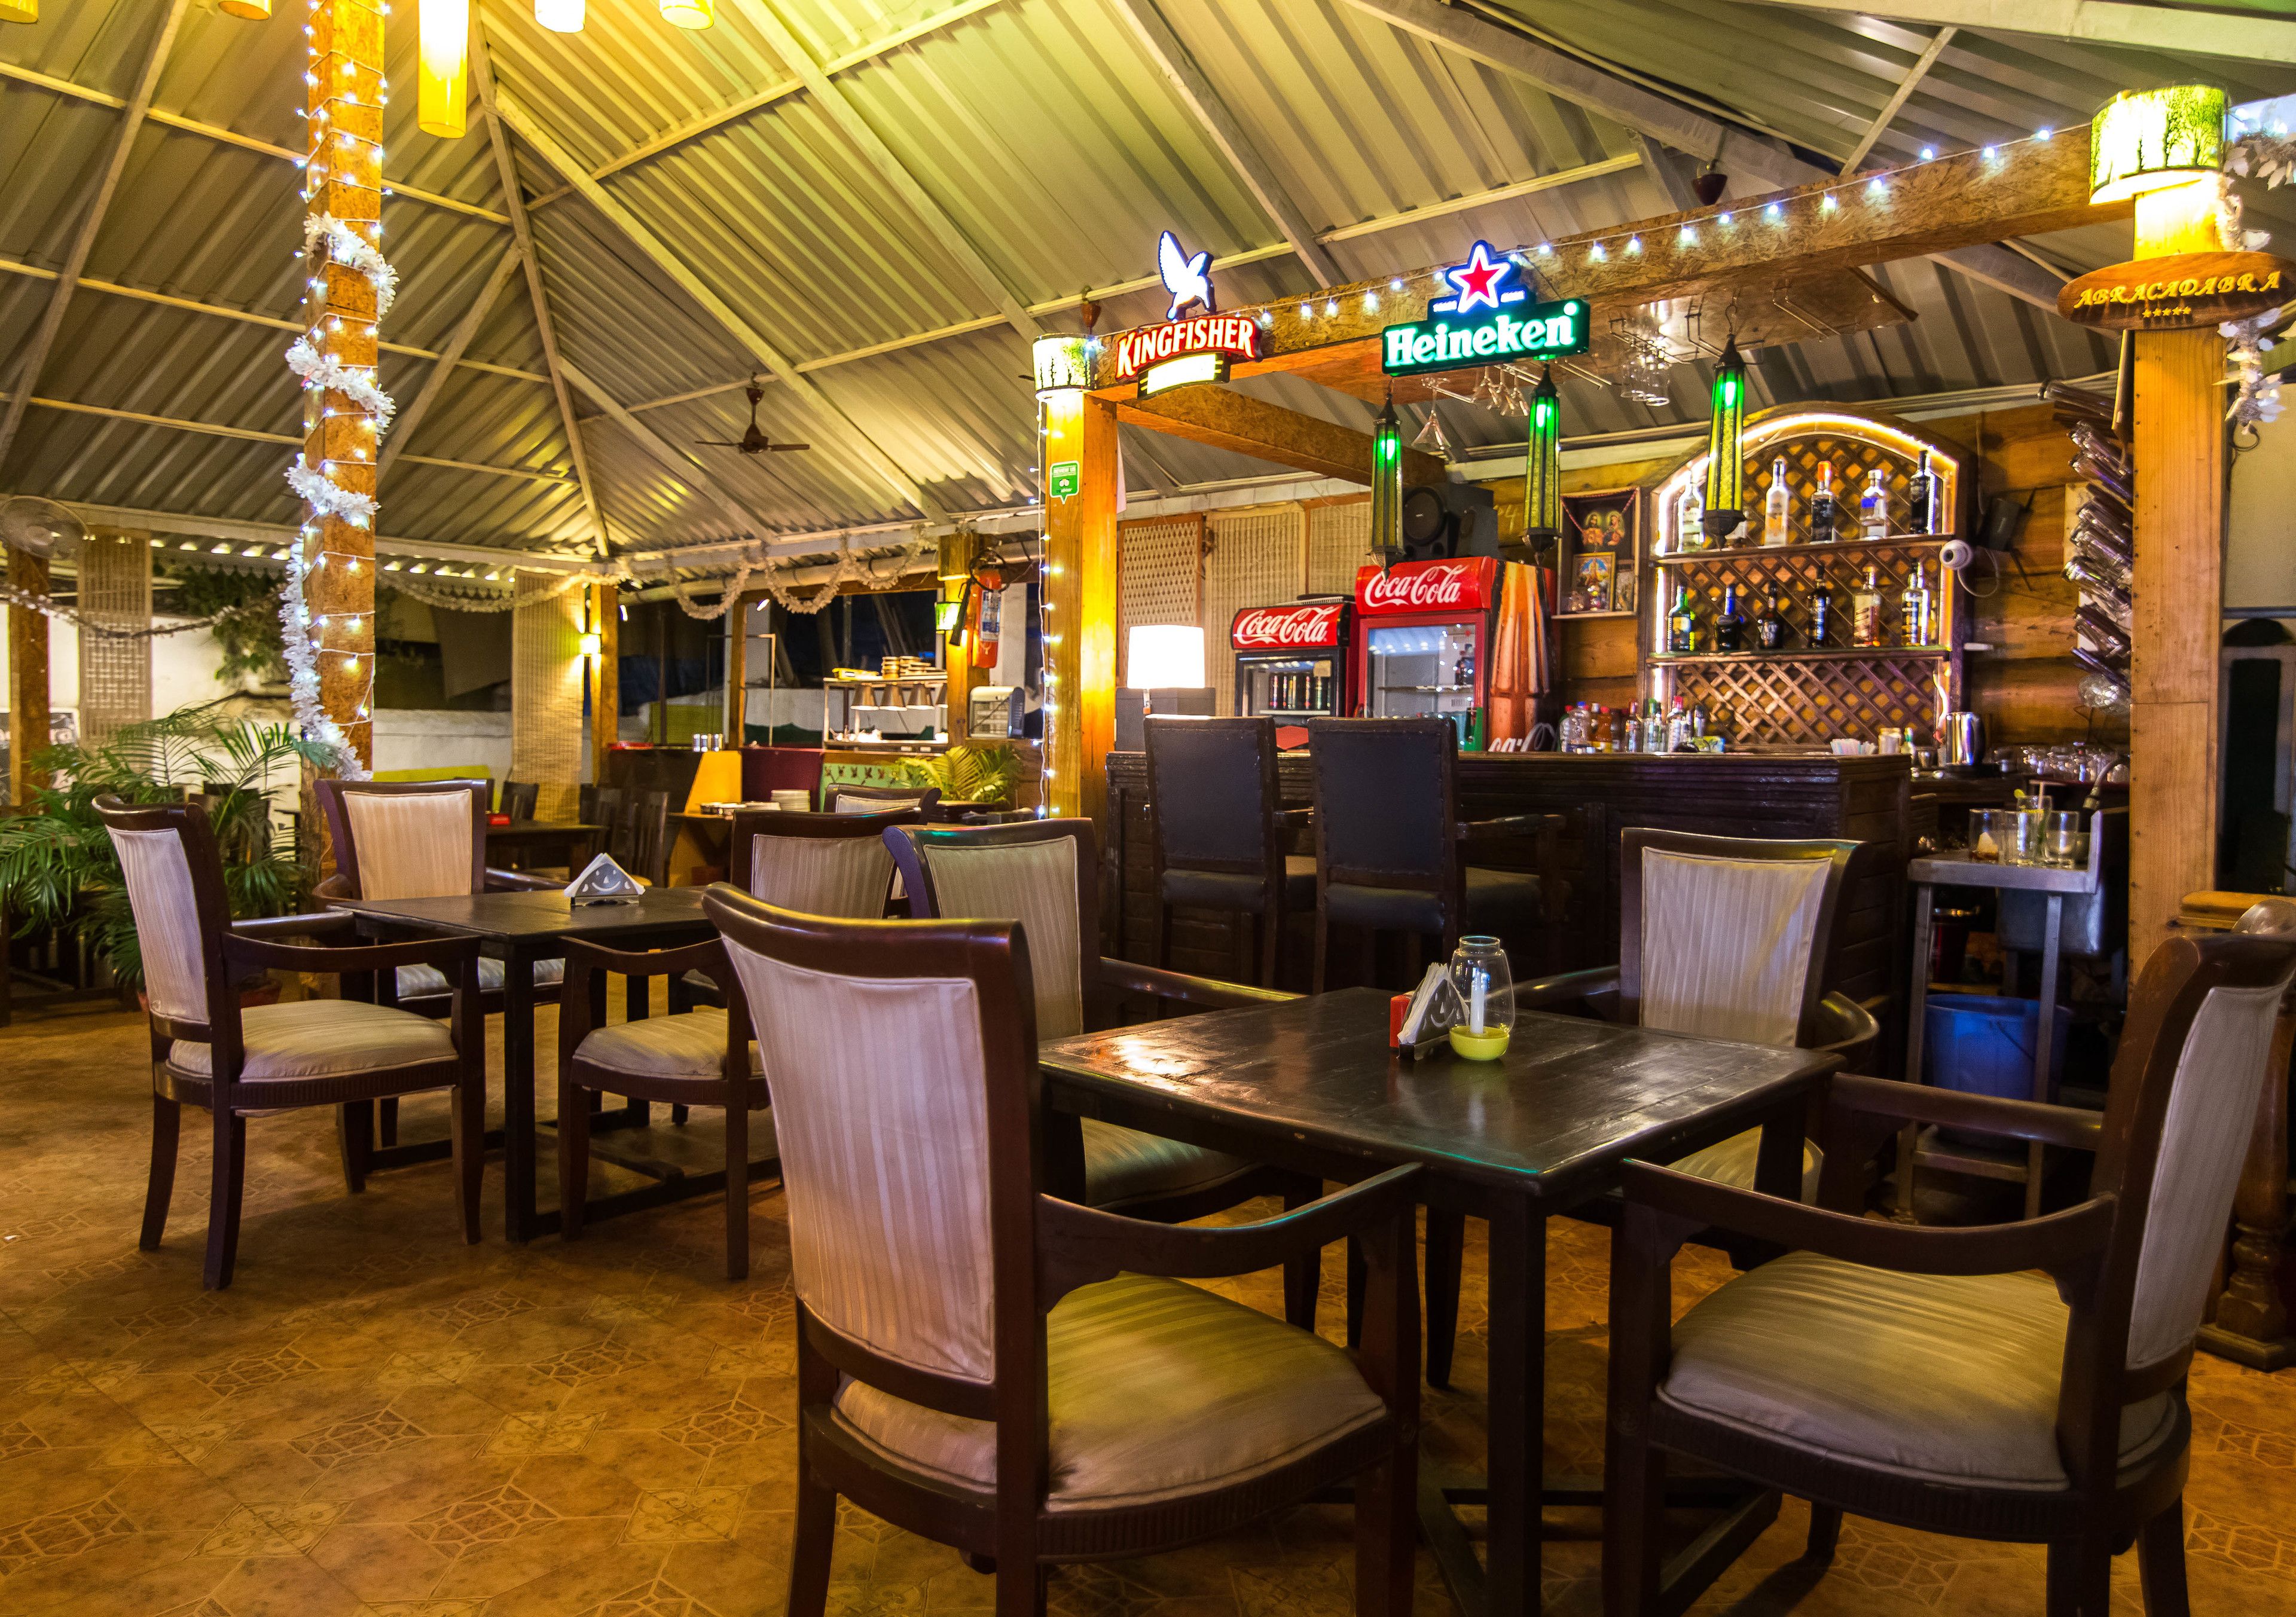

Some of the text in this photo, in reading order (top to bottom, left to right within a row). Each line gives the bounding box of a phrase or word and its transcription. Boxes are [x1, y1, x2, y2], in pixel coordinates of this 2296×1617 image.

[2073, 271, 2281, 309] ABRACADABRA
[1115, 318, 1255, 379] KINGFISHER
[1385, 314, 1577, 367] Heineken
[1364, 564, 1469, 608] Coca-Cola
[1236, 606, 1341, 645] Coca-Cola
